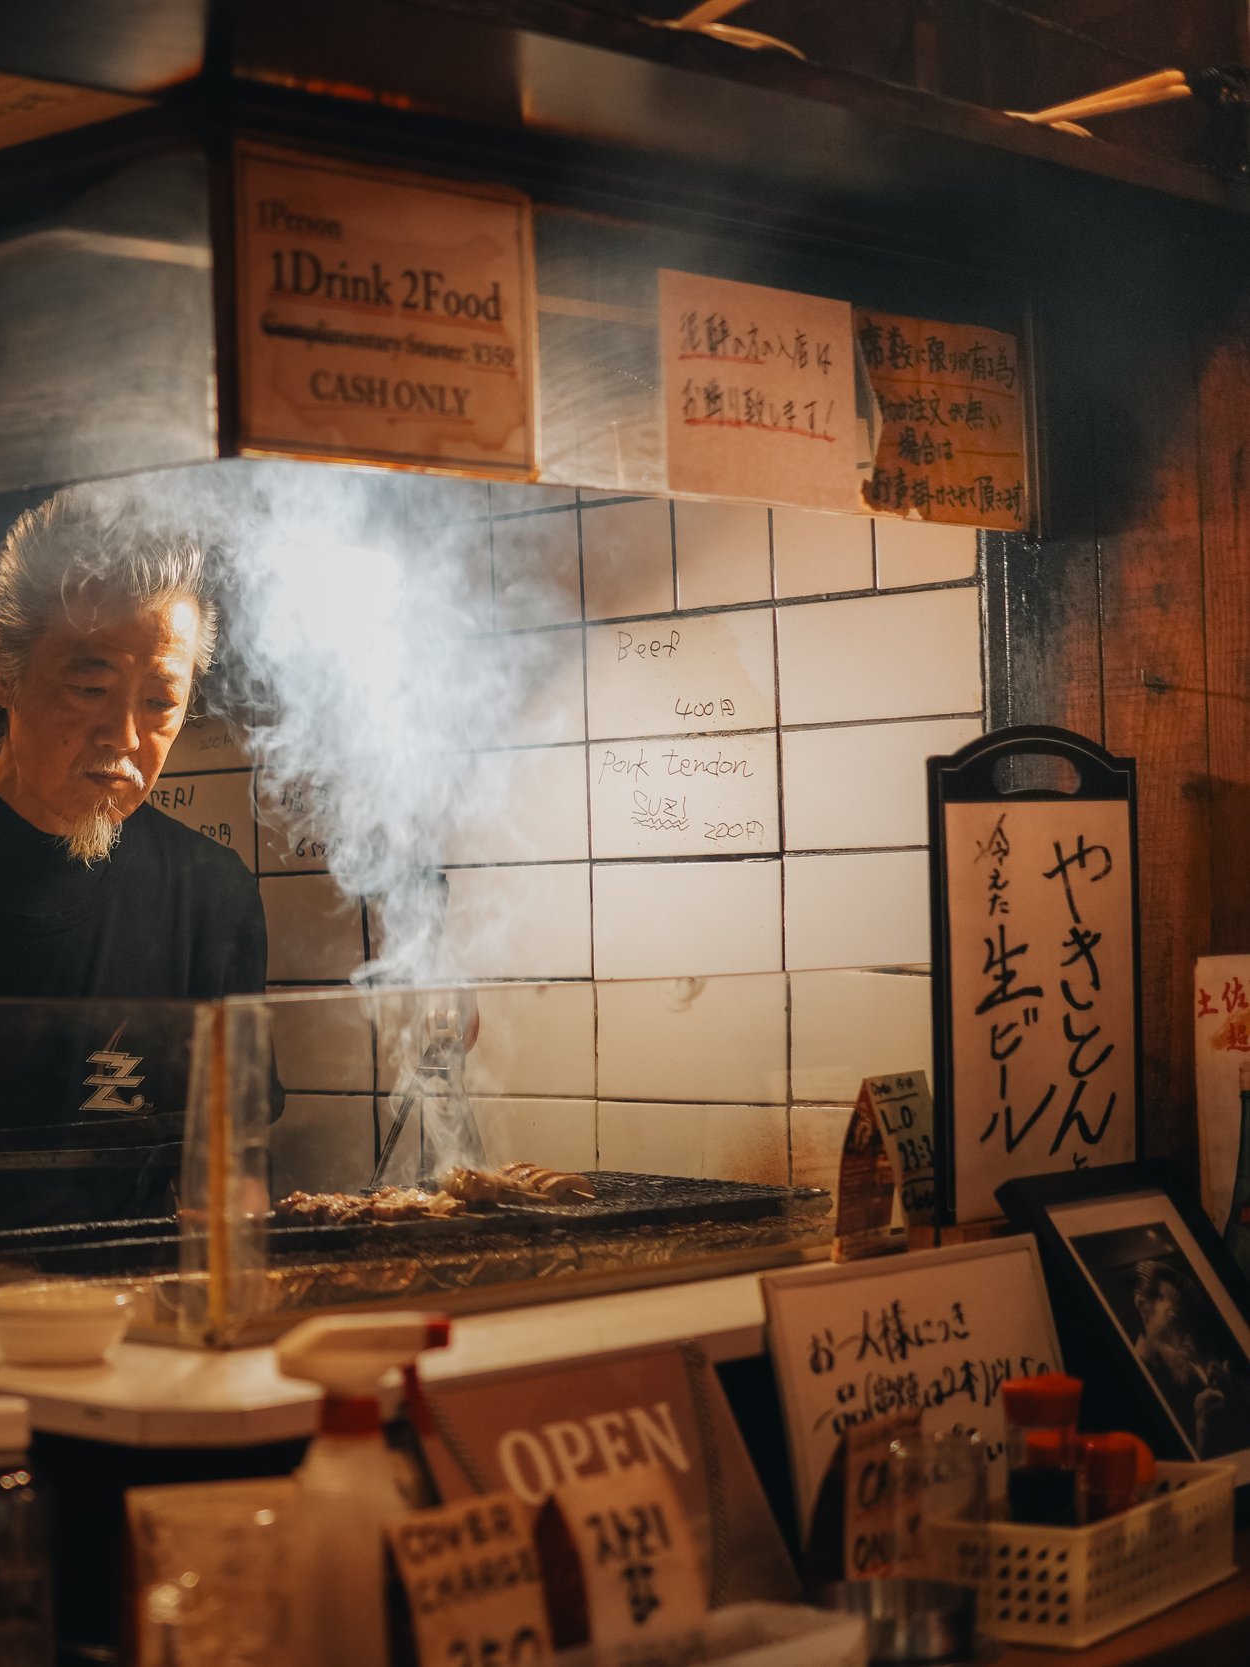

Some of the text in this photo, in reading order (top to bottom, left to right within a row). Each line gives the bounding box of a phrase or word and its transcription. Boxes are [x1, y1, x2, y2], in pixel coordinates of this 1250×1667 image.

[256, 199, 344, 241] 1Person
[271, 249, 503, 323] 1Drink 2Food
[309, 368, 470, 417] CASH ONLY
[617, 629, 681, 664] Beef
[674, 697, 736, 721] 400円
[598, 748, 755, 785] Pork tendon
[631, 789, 687, 820] SUZI
[703, 819, 765, 842] 200円
[973, 812, 1057, 1155] 冷えた生ビール
[496, 1401, 691, 1506] OPEN
